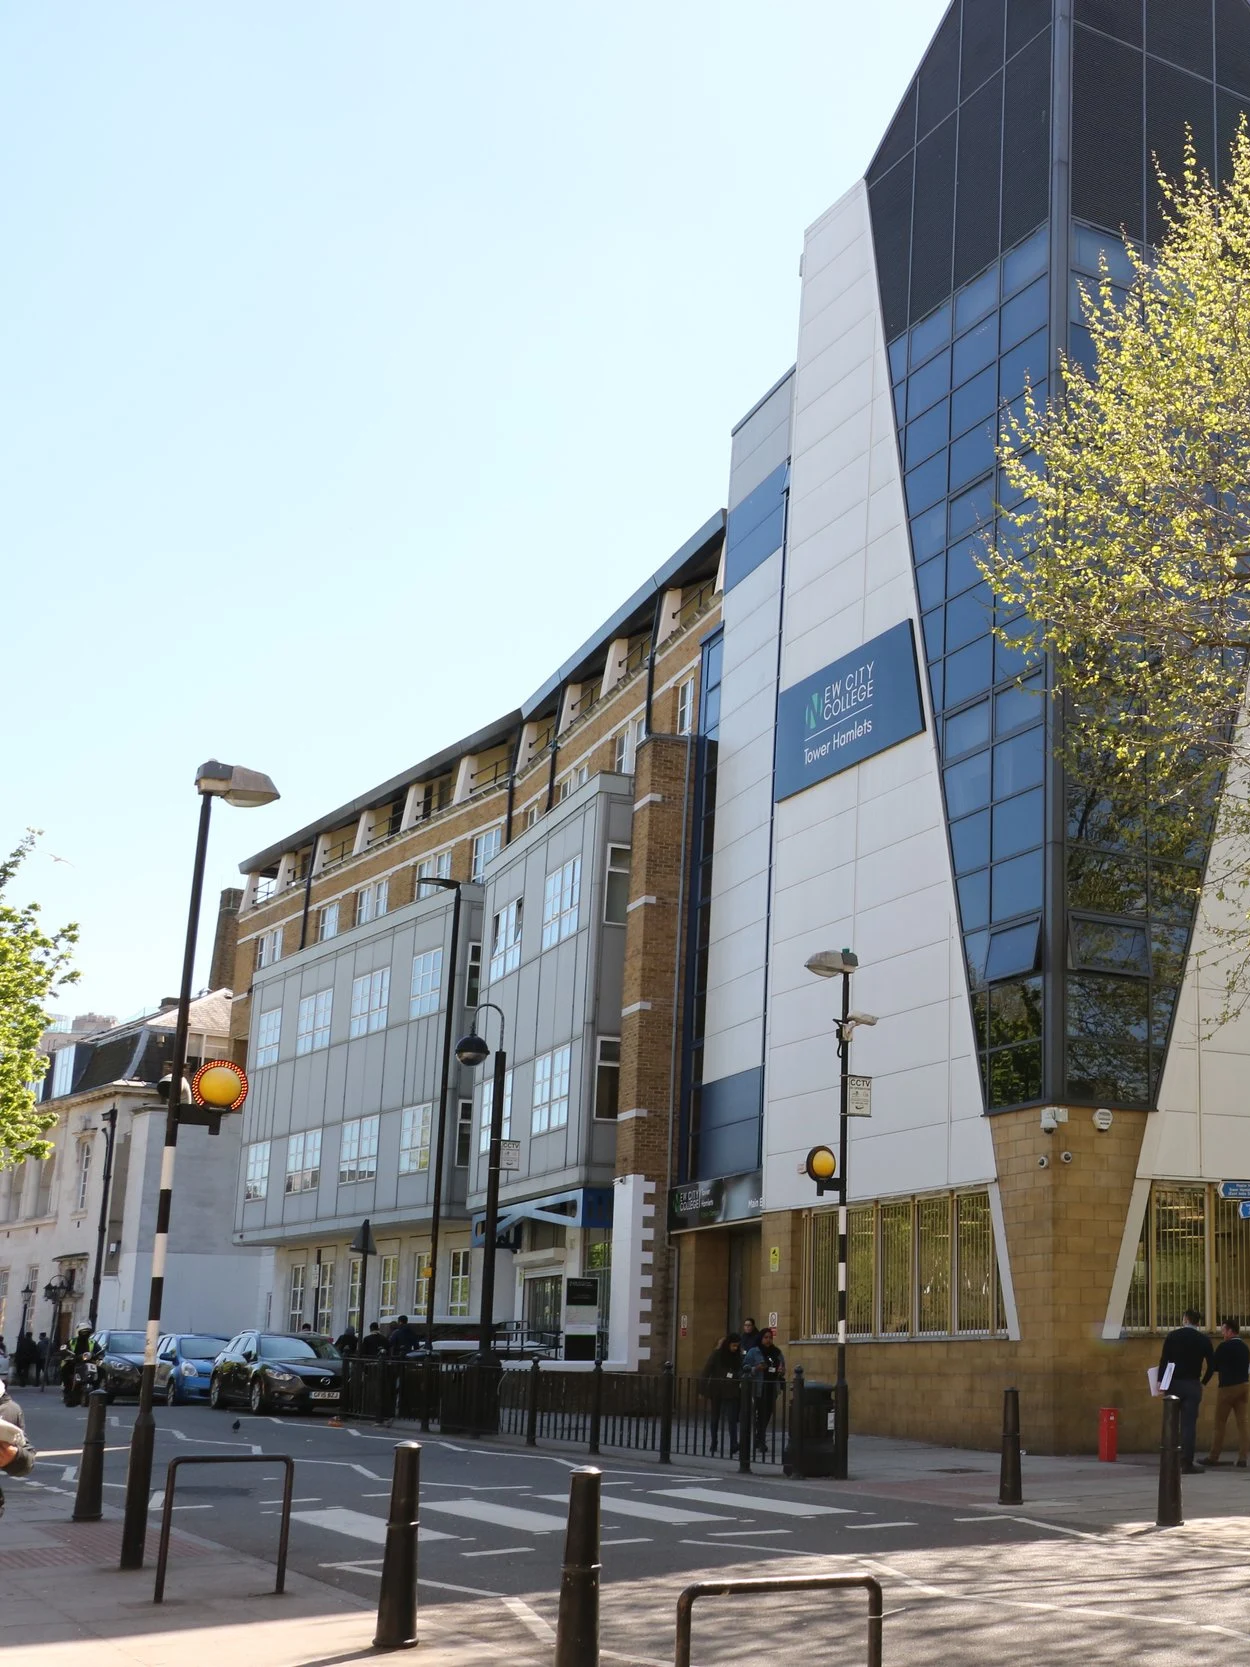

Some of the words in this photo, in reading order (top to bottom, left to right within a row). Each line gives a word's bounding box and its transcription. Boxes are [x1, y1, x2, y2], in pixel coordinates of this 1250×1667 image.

[845, 661, 875, 691] CITY
[823, 680, 873, 721] COLLEGE
[804, 741, 830, 766] Tower
[833, 719, 872, 751] Hamlets
[850, 1079, 871, 1087] CCTV
[688, 1189, 699, 1201] CITY
[680, 1199, 699, 1211] COLLEGE
[747, 1198, 759, 1209] Main
